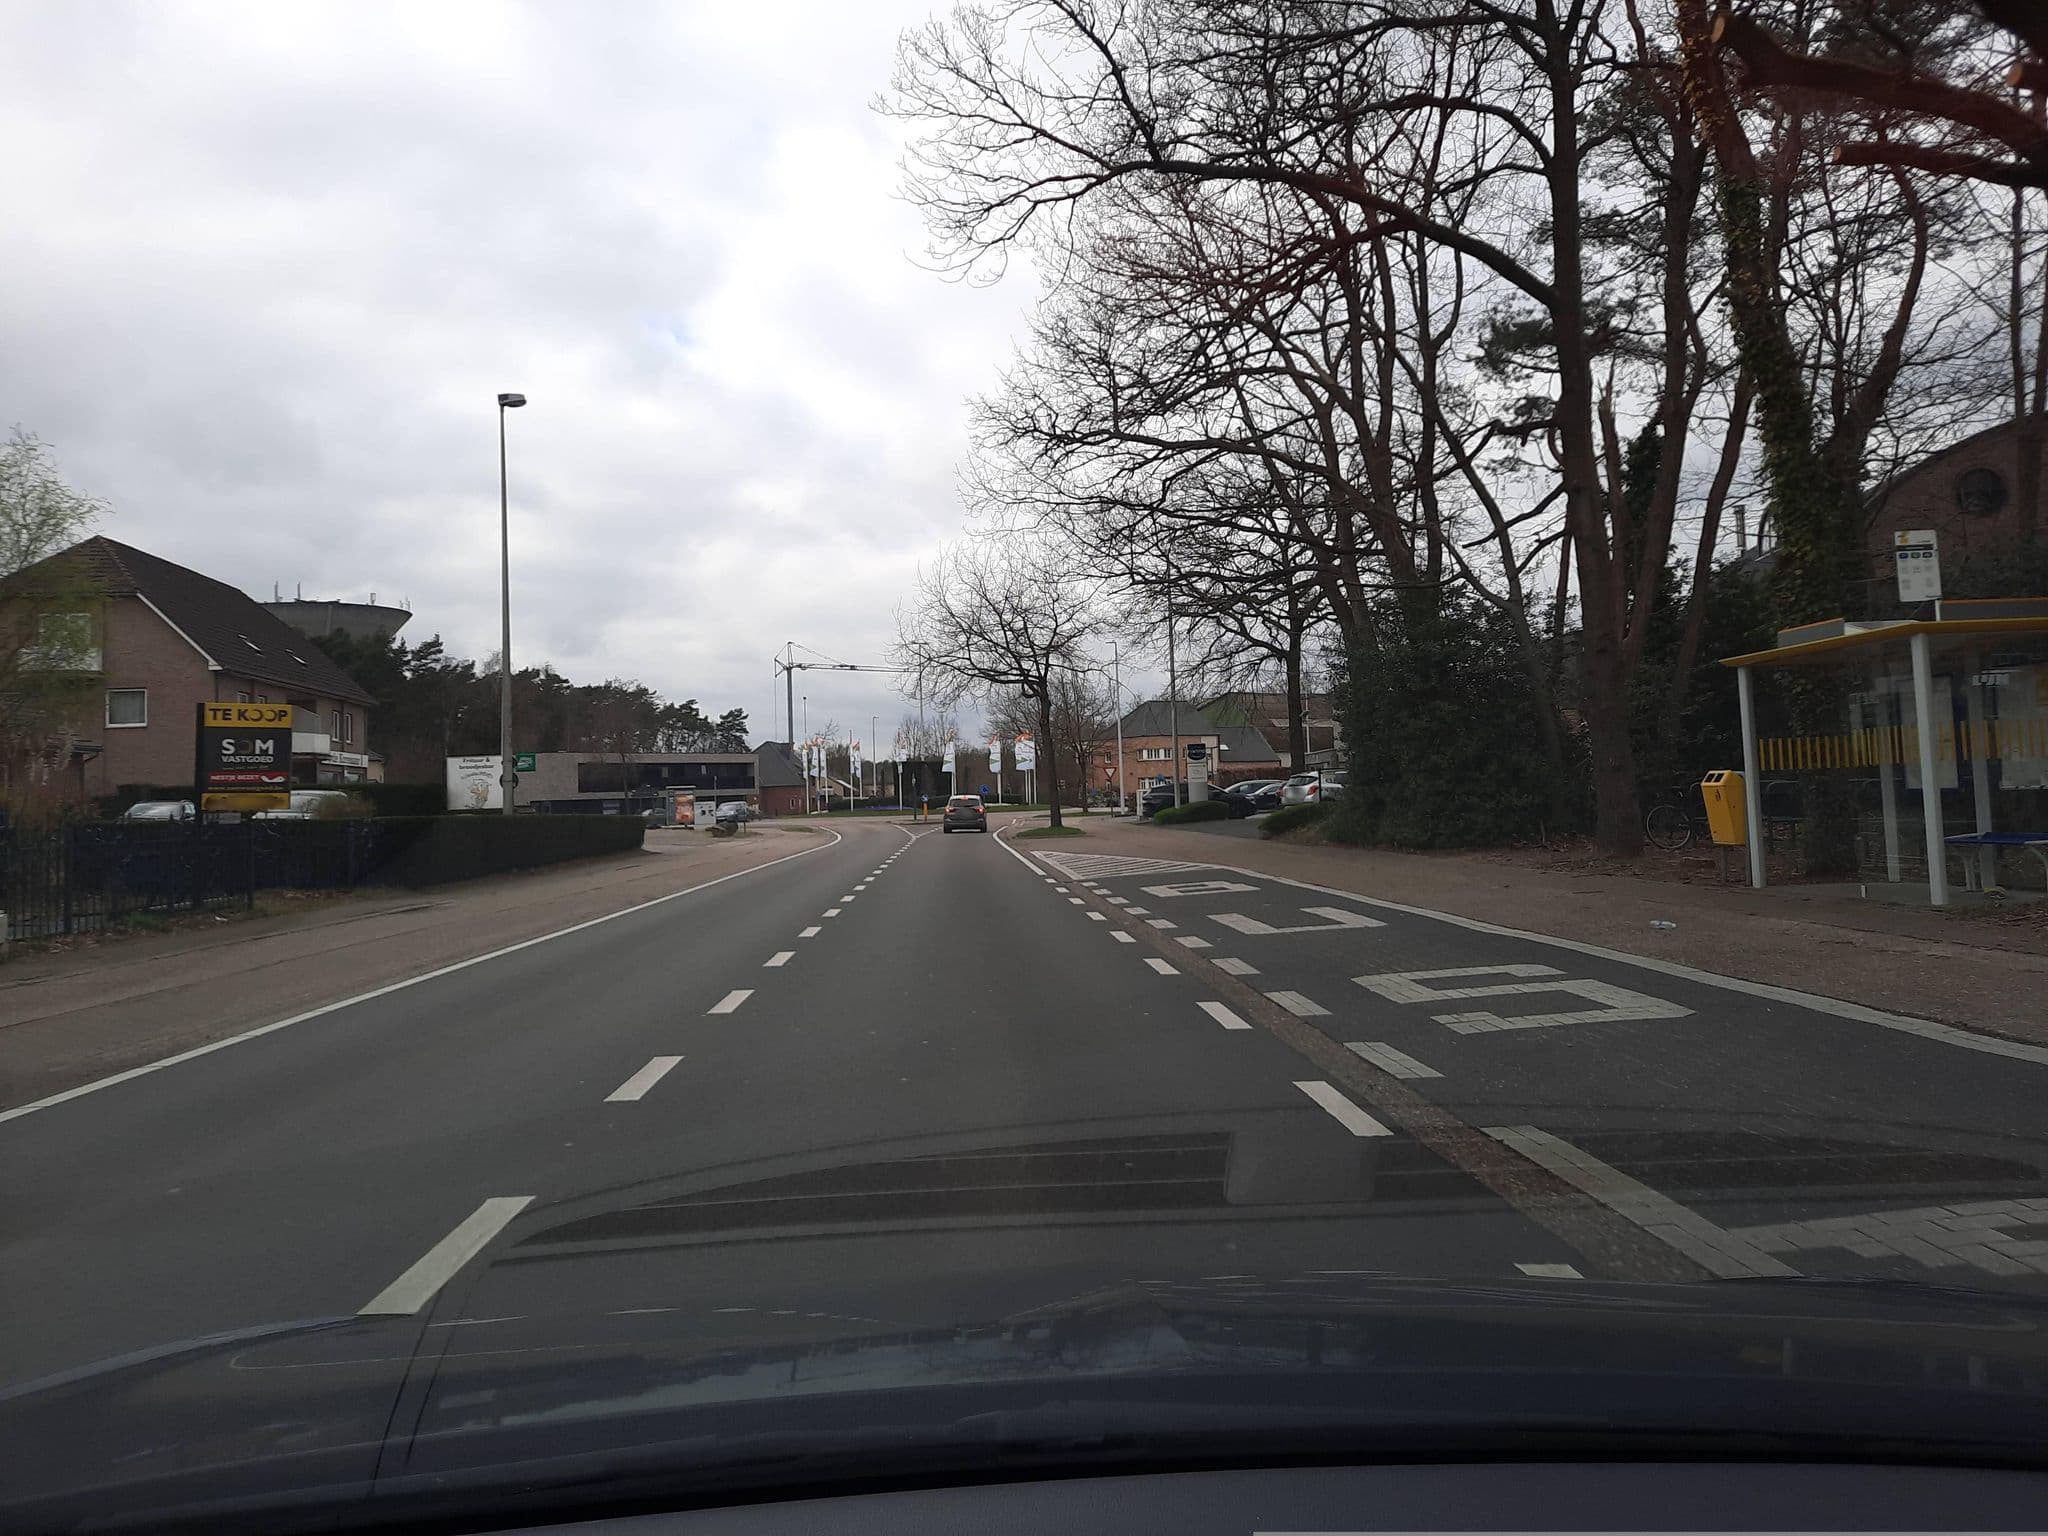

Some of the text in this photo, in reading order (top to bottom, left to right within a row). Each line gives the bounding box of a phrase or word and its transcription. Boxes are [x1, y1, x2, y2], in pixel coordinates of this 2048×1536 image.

[208, 708, 288, 722] TE KOOP
[221, 755, 274, 763] VASTGOED
